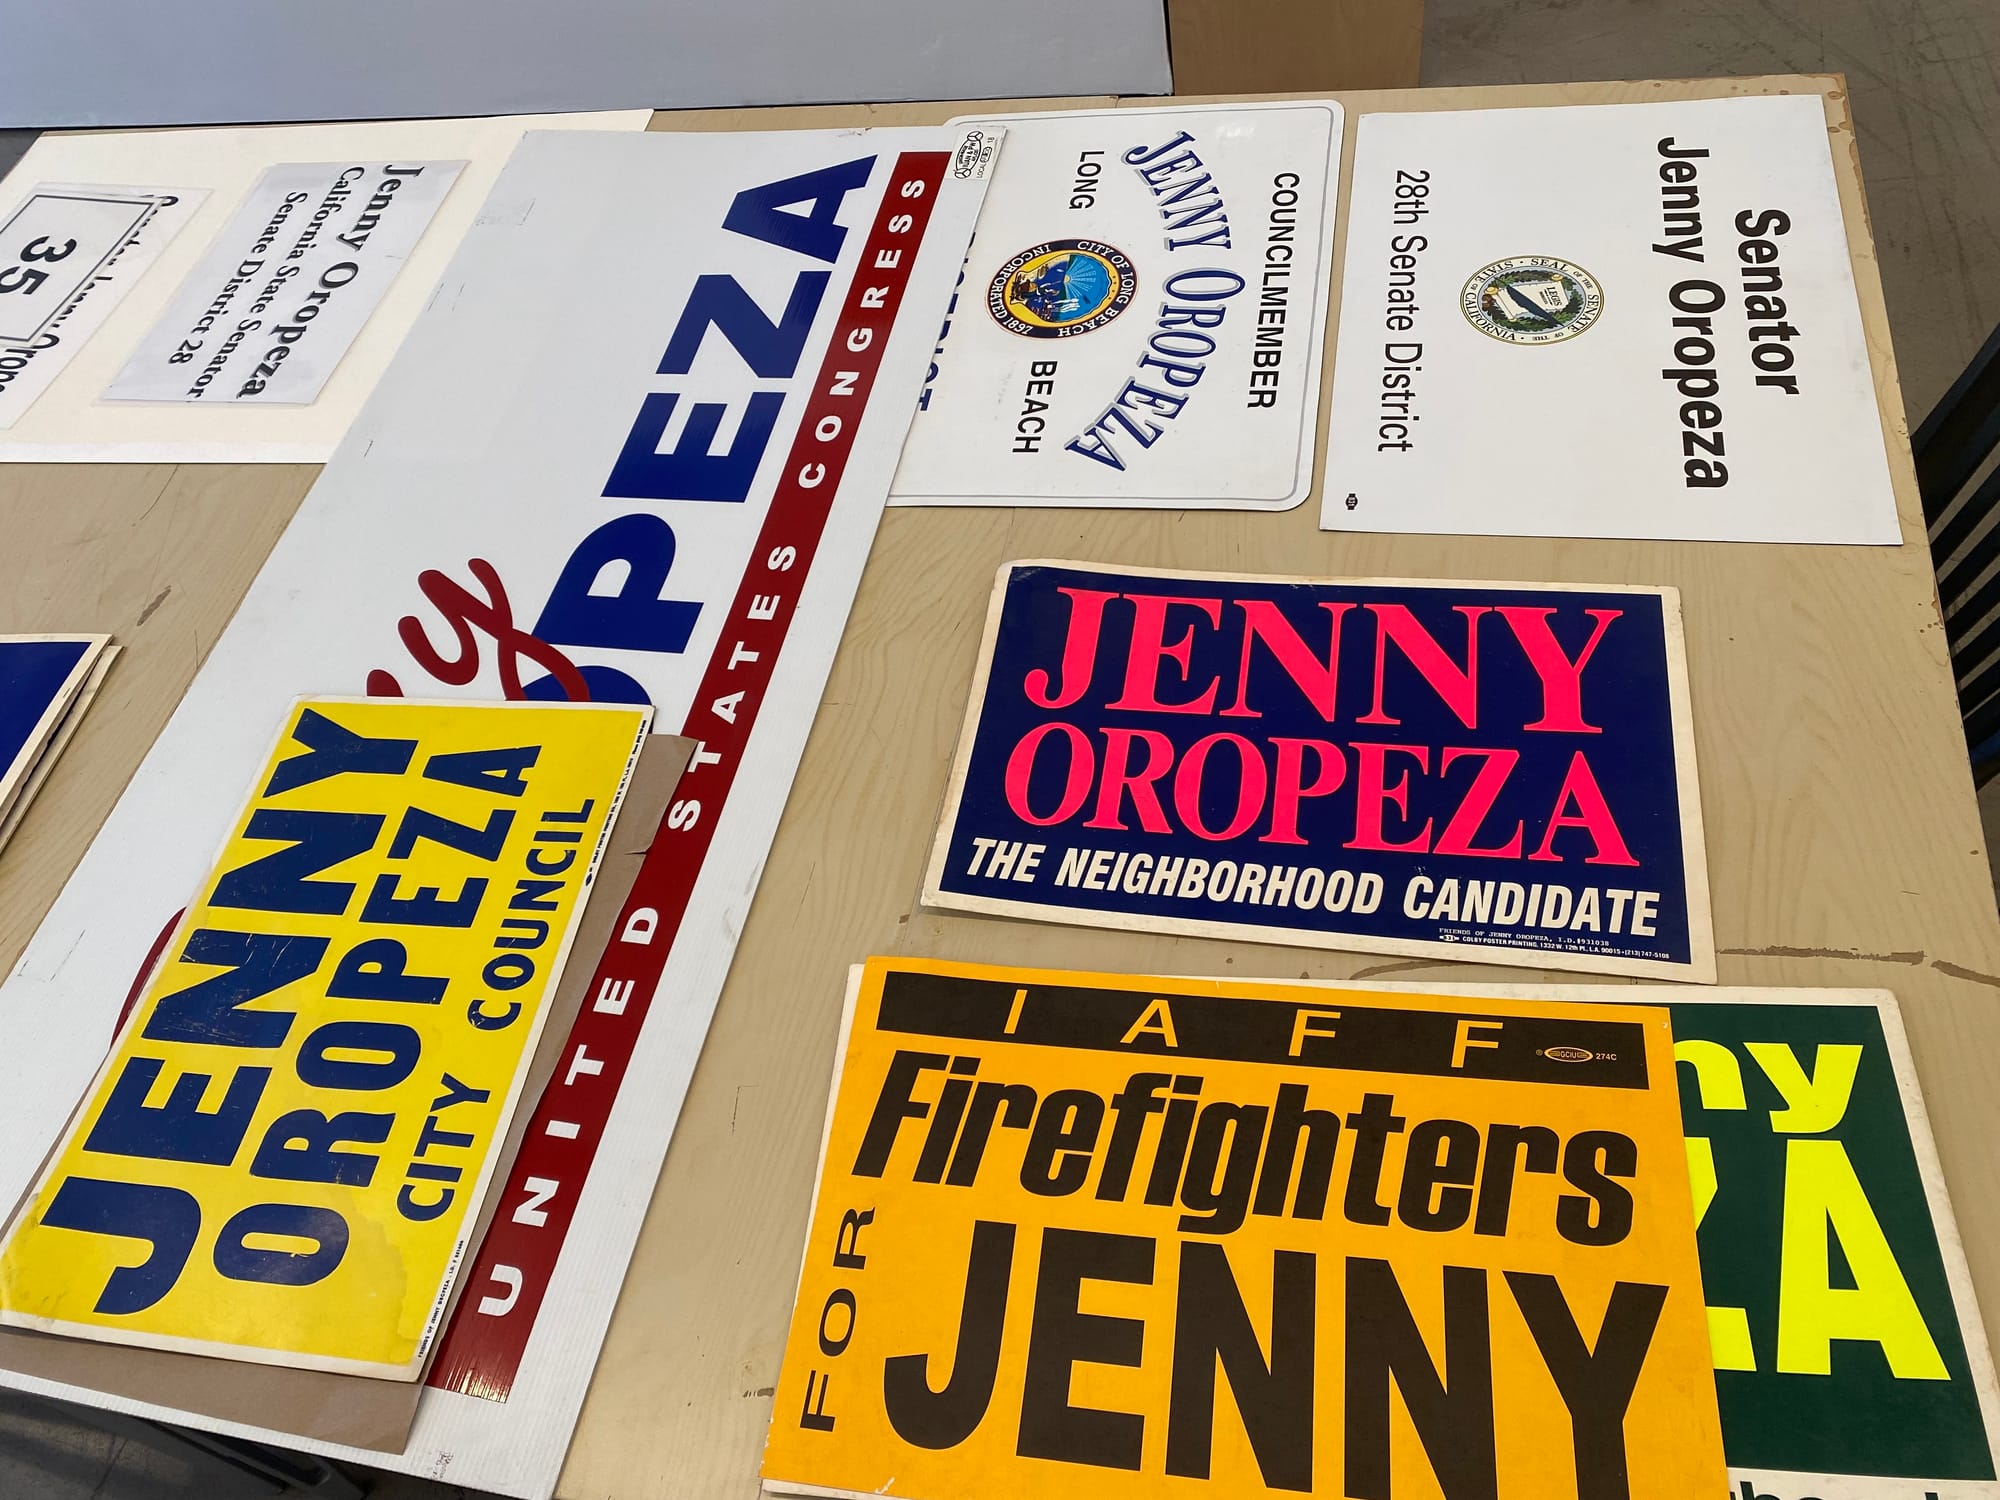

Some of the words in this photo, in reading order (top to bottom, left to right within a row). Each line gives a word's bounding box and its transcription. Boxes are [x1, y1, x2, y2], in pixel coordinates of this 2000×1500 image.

[251, 191, 309, 254] Senate
[286, 166, 365, 260] California
[336, 164, 425, 251] Jenny
[1068, 151, 1105, 209] LONG
[1120, 130, 1232, 253] JENNY
[1395, 170, 1431, 225] 28th
[1651, 136, 1711, 263] Jenny
[0, 235, 77, 295] 35
[250, 265, 300, 313] State
[989, 244, 1051, 319] INCORPORATED
[1077, 241, 1114, 257] CITY
[1111, 255, 1130, 269] OF
[1116, 271, 1135, 304] LONG
[1247, 172, 1300, 409] COUNCILMEMBER
[1385, 234, 1428, 331] Senate
[1476, 260, 1514, 284] STATE
[1530, 258, 1570, 272] SEAL
[1567, 294, 1599, 333] SENATE
[191, 259, 265, 334] District
[236, 261, 359, 399] Oropeza
[1002, 313, 1034, 335] 1897
[1058, 307, 1119, 337] BEACH
[1465, 292, 1516, 341] CALIFORNIA
[1546, 286, 1563, 306] LEGIS
[1734, 208, 1802, 396] Senator
[168, 339, 203, 364] 28
[186, 319, 262, 398] Senator
[1063, 267, 1246, 472] OROPEZA
[1377, 342, 1424, 453] District
[1661, 279, 1730, 489] Oropeza
[522, 153, 878, 712] PEZA
[1012, 360, 1058, 453] BEACH
[1023, 586, 1624, 735] JENNY
[478, 906, 659, 1317] UNITED
[667, 544, 797, 832] STATES
[797, 178, 925, 489] CONGRESS
[1004, 722, 1640, 867] OROPEZA
[967, 837, 1046, 885] THE
[1054, 847, 1386, 916] NEIGHBORHOOD
[1403, 876, 1661, 937] CANDIDATE
[40, 707, 421, 1315] JENNY
[212, 744, 542, 1287] OROPEZA
[396, 1072, 492, 1223] CITY
[467, 798, 595, 1033] COUNCIL
[1595, 1052, 1617, 1061] 274C
[850, 1048, 1638, 1247] Firefighters
[799, 1206, 875, 1432] FOR
[881, 1220, 1670, 1500] JENNY
